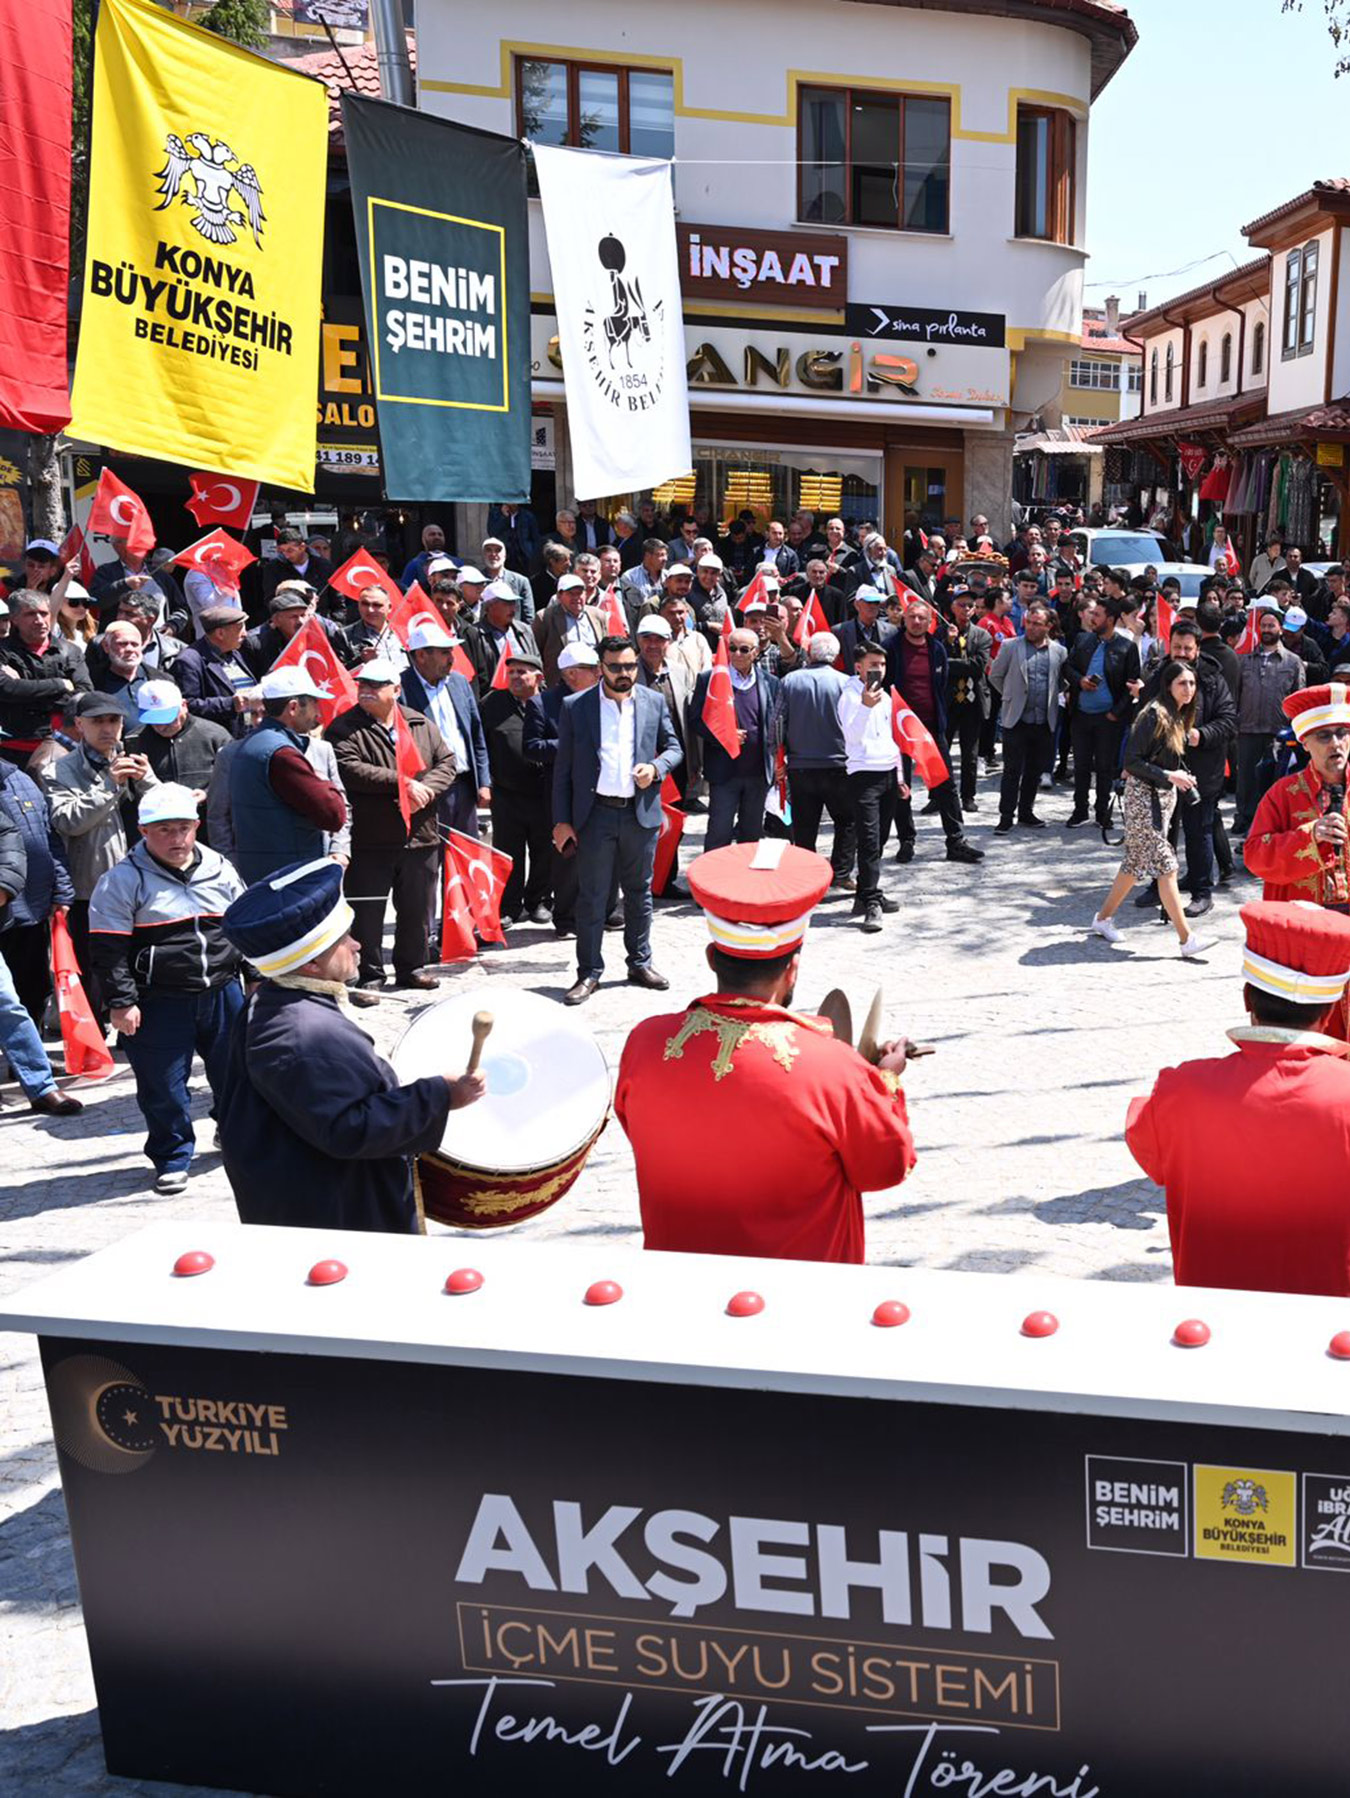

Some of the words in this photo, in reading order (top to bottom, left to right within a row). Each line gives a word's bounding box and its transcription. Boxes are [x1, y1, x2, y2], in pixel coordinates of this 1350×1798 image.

[154, 240, 255, 300] KONYA
[383, 254, 495, 315] BENİM
[690, 234, 839, 288] İNŞAAT
[91, 259, 293, 356] BÜYÜKŞEHİR
[892, 319, 920, 332] sina
[926, 313, 987, 340] pırlanta
[134, 317, 258, 371] BELEDİYESİ
[385, 309, 496, 359] ŞEHRİM
[620, 373, 649, 389] 1854
[336, 452, 362, 465] 189
[1095, 1480, 1179, 1508] BENİM
[1096, 1506, 1179, 1530] ŞEHRİM
[1203, 1527, 1287, 1546] BÜYÜKŞEHİR
[1220, 1543, 1270, 1554] BELEDİYESİ
[1224, 1518, 1266, 1531] KONYA
[454, 1493, 1055, 1640] AKŞEHİR
[481, 1609, 619, 1672] İÇME
[635, 1635, 792, 1689] SUYU
[810, 1646, 1034, 1715] SİSTEMİ
[430, 1676, 642, 1766] Temel
[656, 1693, 869, 1792] Atma
[865, 1721, 1100, 1798] Töreni
